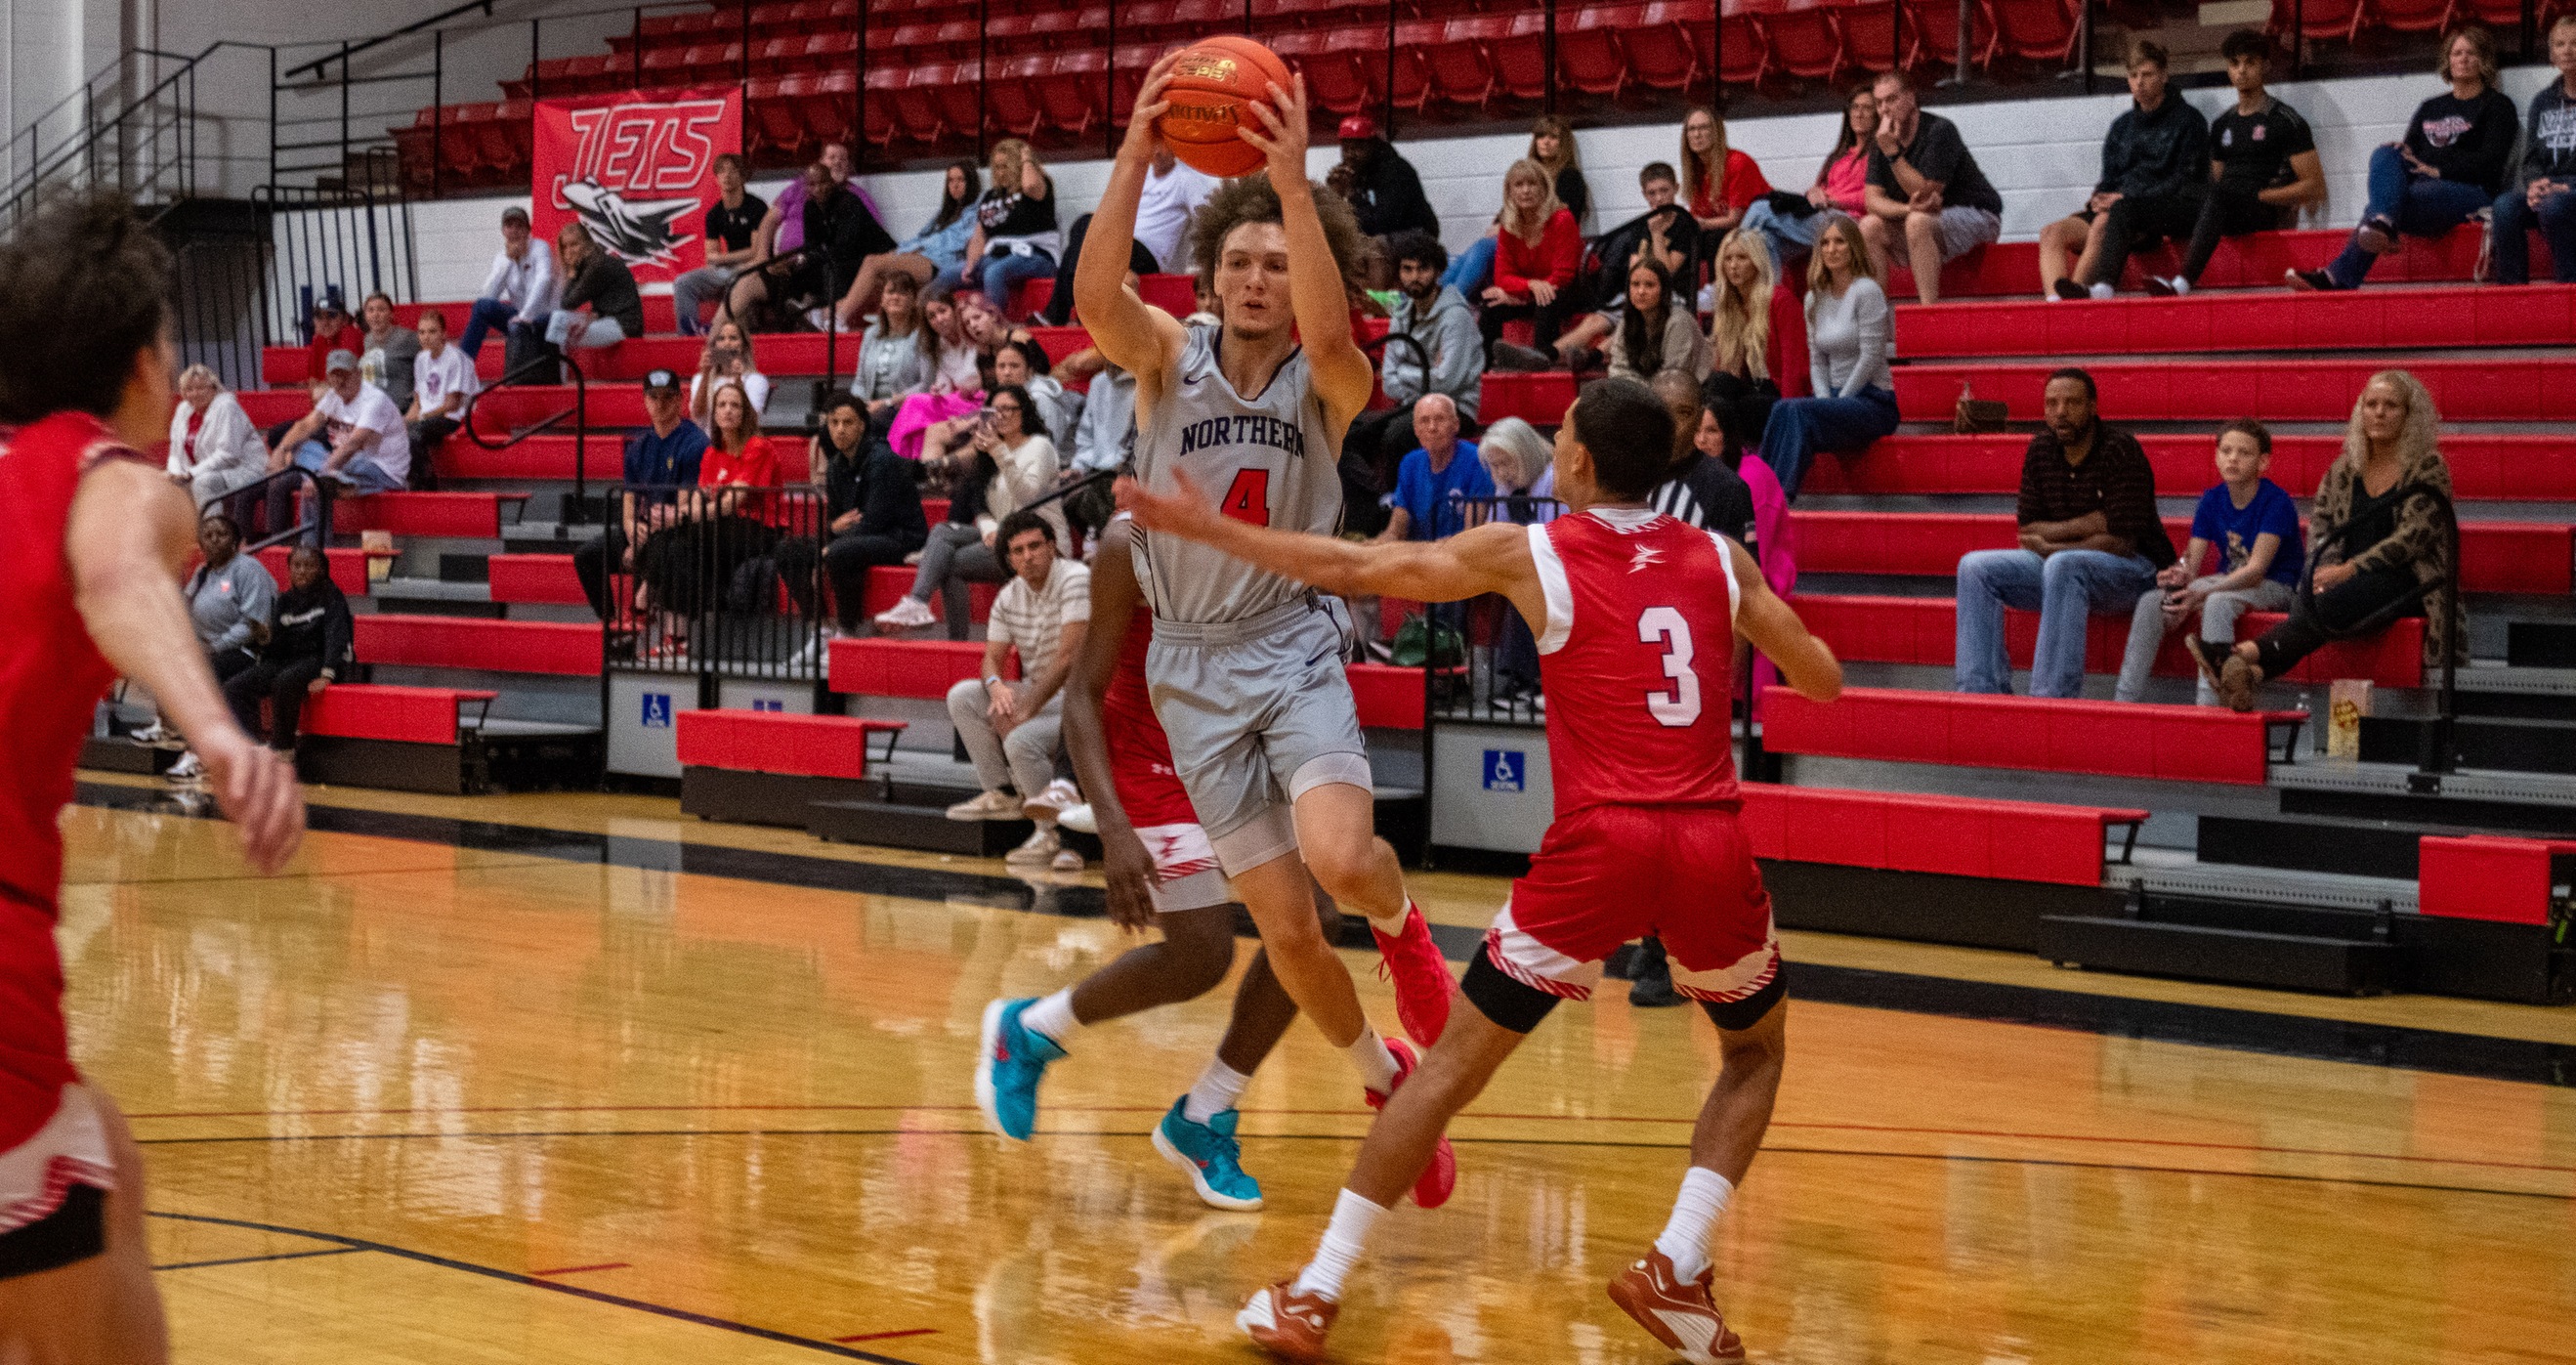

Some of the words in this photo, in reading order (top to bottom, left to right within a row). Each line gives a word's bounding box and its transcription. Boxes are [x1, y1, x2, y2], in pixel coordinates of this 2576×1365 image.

[1167, 103, 1241, 126] SPALDIN
[552, 99, 726, 209] JETS
[1179, 415, 1305, 457] NORTHERN
[1220, 466, 1270, 527] 4
[1637, 606, 1702, 726] 3
